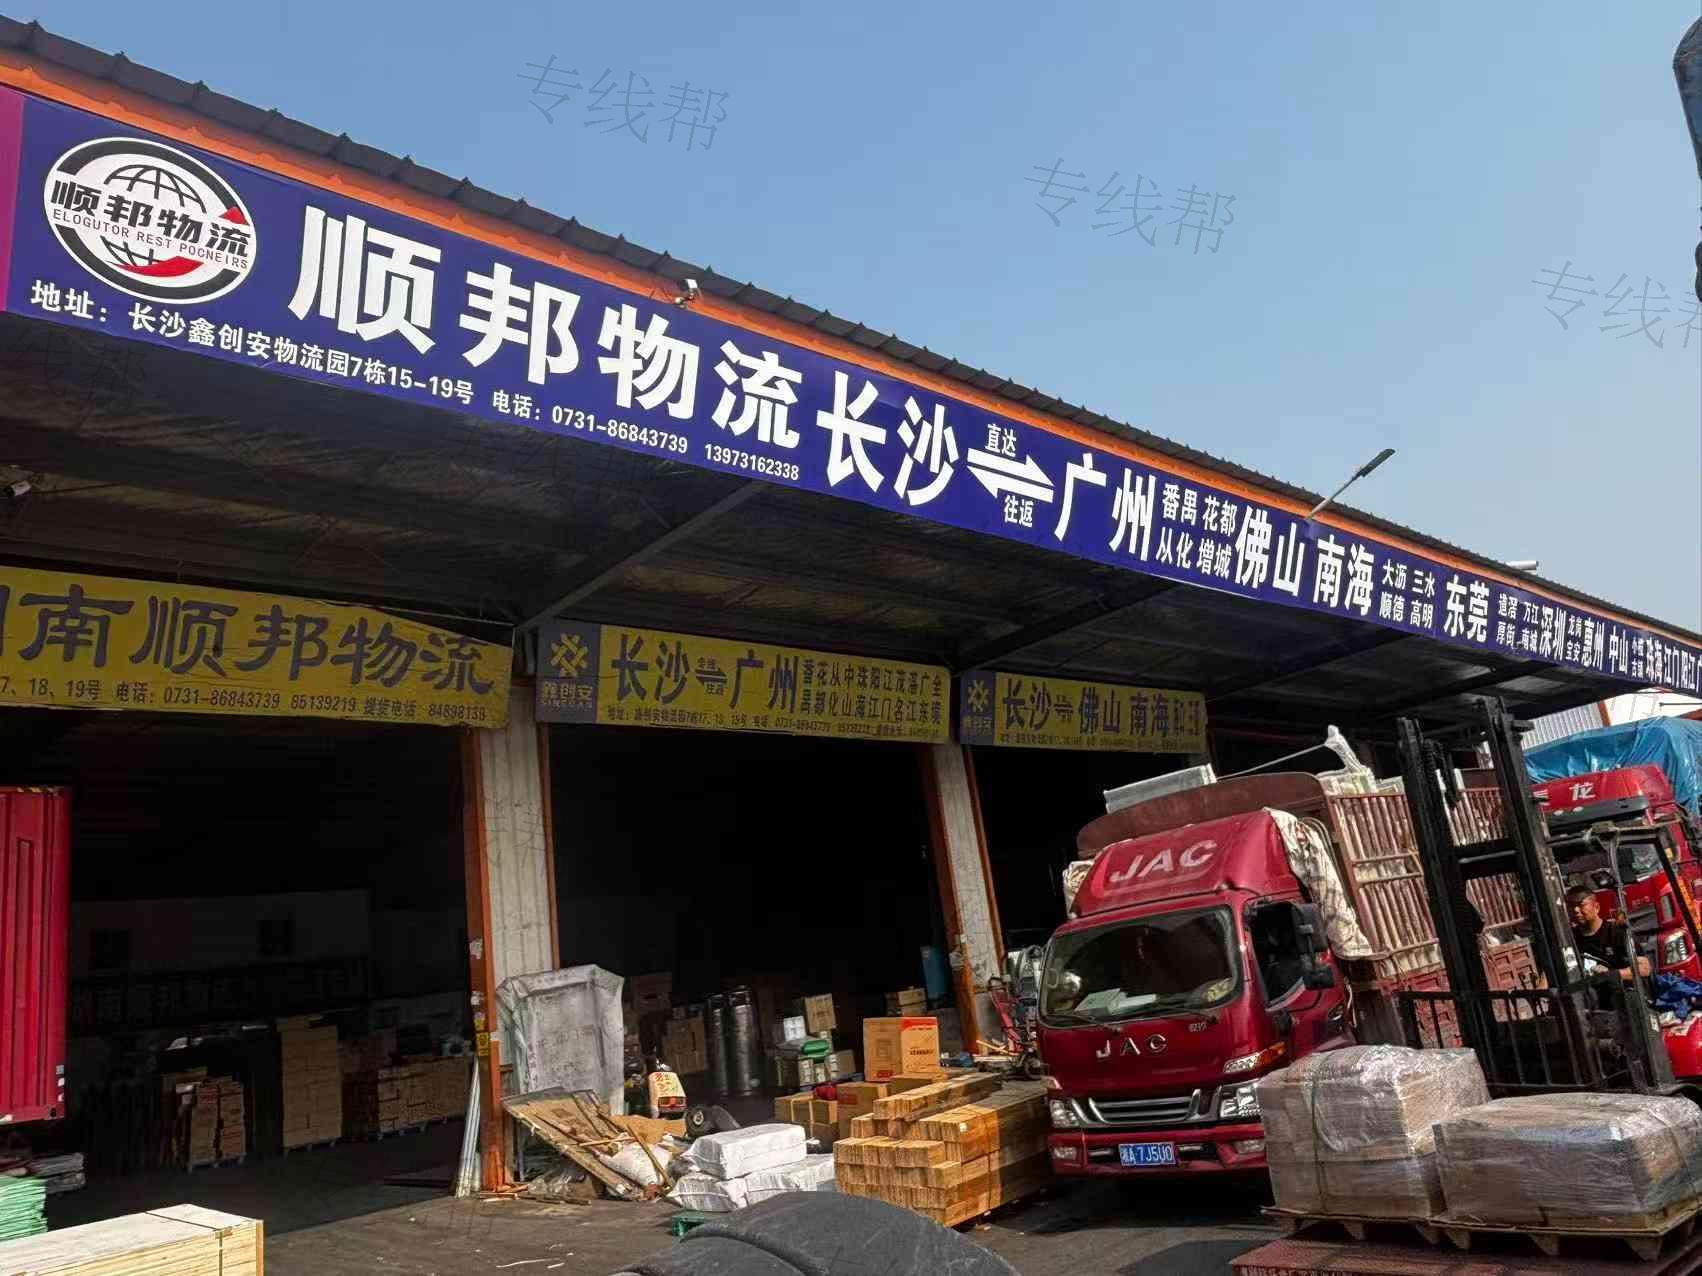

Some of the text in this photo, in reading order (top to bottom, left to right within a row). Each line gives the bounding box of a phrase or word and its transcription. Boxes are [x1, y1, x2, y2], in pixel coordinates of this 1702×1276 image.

[51, 180, 251, 257] 顺邦物流
[53, 209, 129, 238] ELOGUTOR
[137, 231, 171, 249] REST
[288, 204, 959, 506] 顺邦物流 长沙
[128, 302, 474, 405] 长沙鑫创安物流园7栋15-19号
[552, 405, 688, 454] 0731-86843739
[704, 444, 799, 480] 13973162338
[985, 423, 1017, 457] 直达
[1003, 495, 1034, 528] 往返
[1054, 453, 1156, 561] 广州
[1162, 483, 1238, 537] 番禺 花都
[1156, 527, 1232, 580] 从化 增城
[1235, 505, 1375, 616] 佛山 南海
[1382, 559, 1435, 598] 大沥 三水
[1379, 591, 1434, 629] 顺德 高明
[1443, 574, 1490, 643] 东莞
[1523, 601, 1539, 625] 万江
[1539, 604, 1567, 661] 深圳
[0, 583, 495, 694] 南顺邦物流
[1581, 617, 1629, 674] 惠州 中山
[611, 633, 799, 714] 长沙 广州
[1003, 678, 1051, 731] 长沙
[1078, 686, 1121, 734] 佛山
[1110, 839, 1217, 883] JAC
